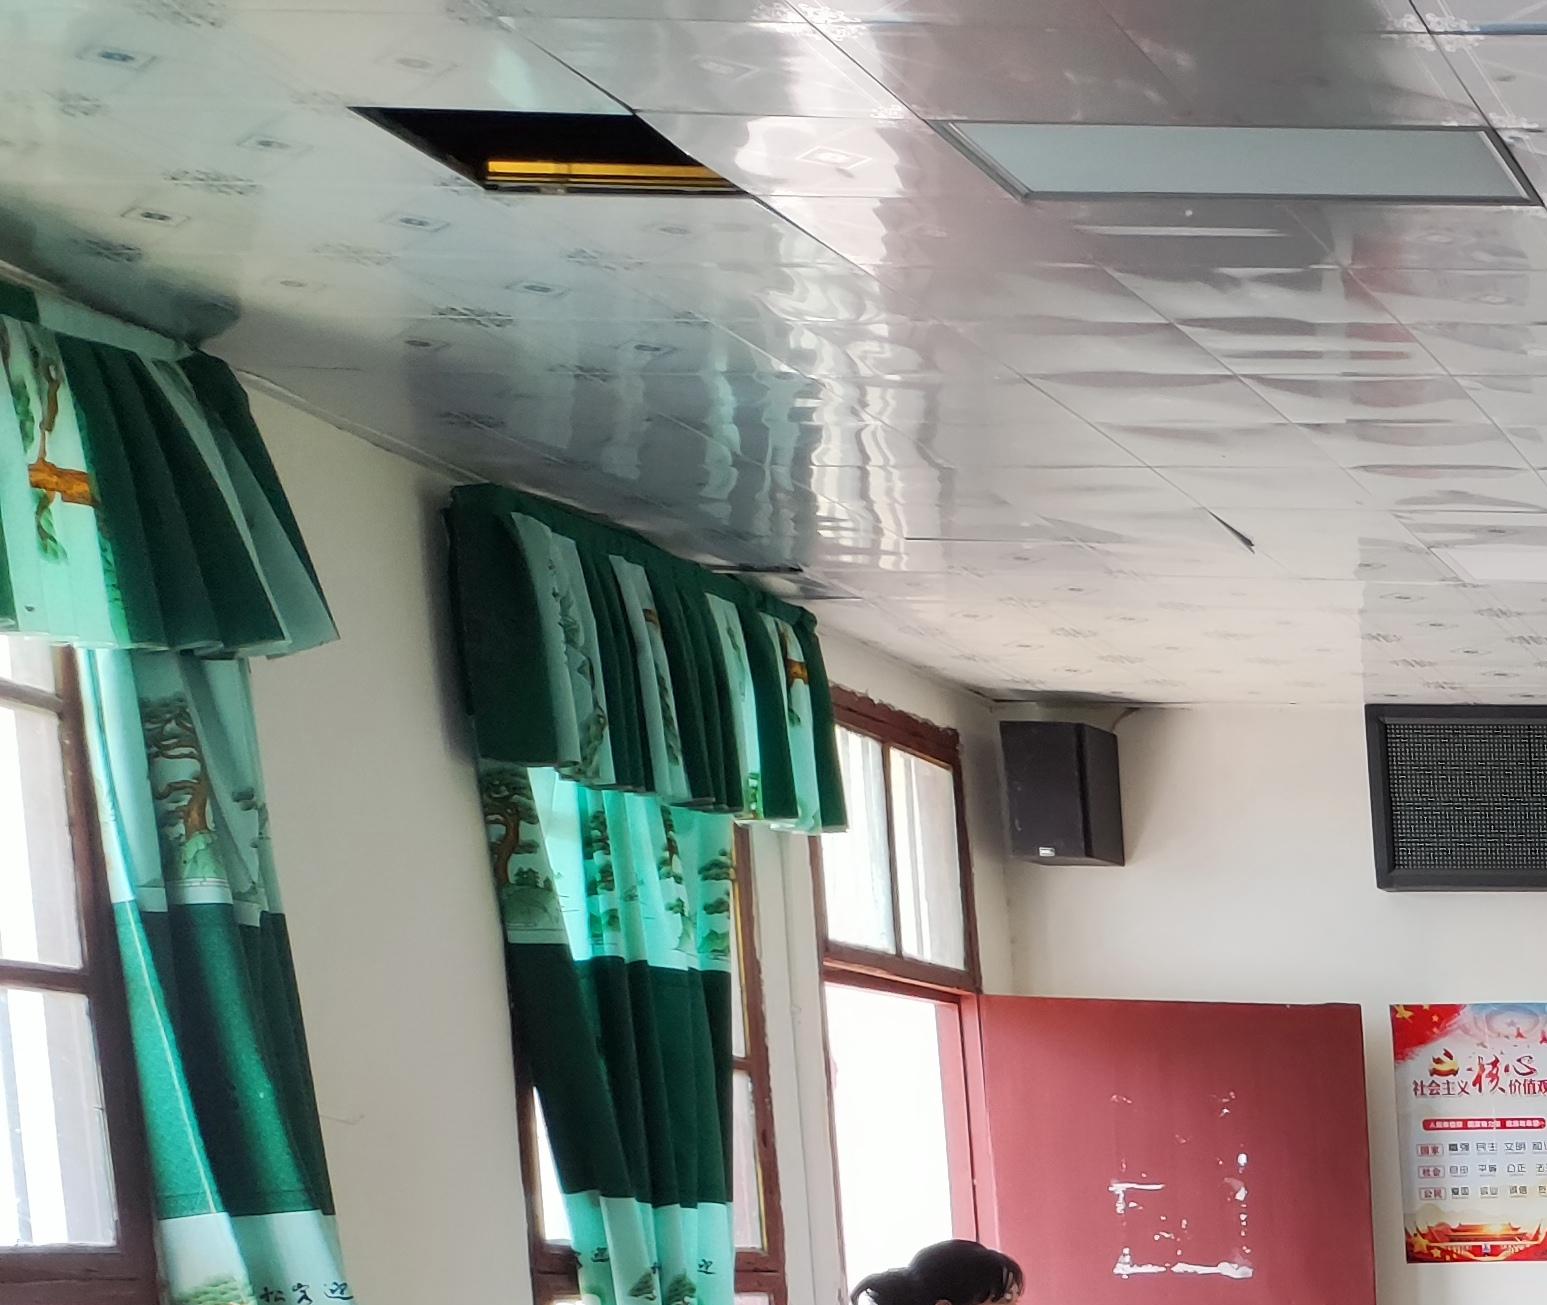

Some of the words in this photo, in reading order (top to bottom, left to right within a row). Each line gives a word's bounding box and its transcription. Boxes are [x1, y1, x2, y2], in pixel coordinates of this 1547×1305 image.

[1413, 1079, 1471, 1096] 社会主义
[1467, 1054, 1538, 1094] 核心
